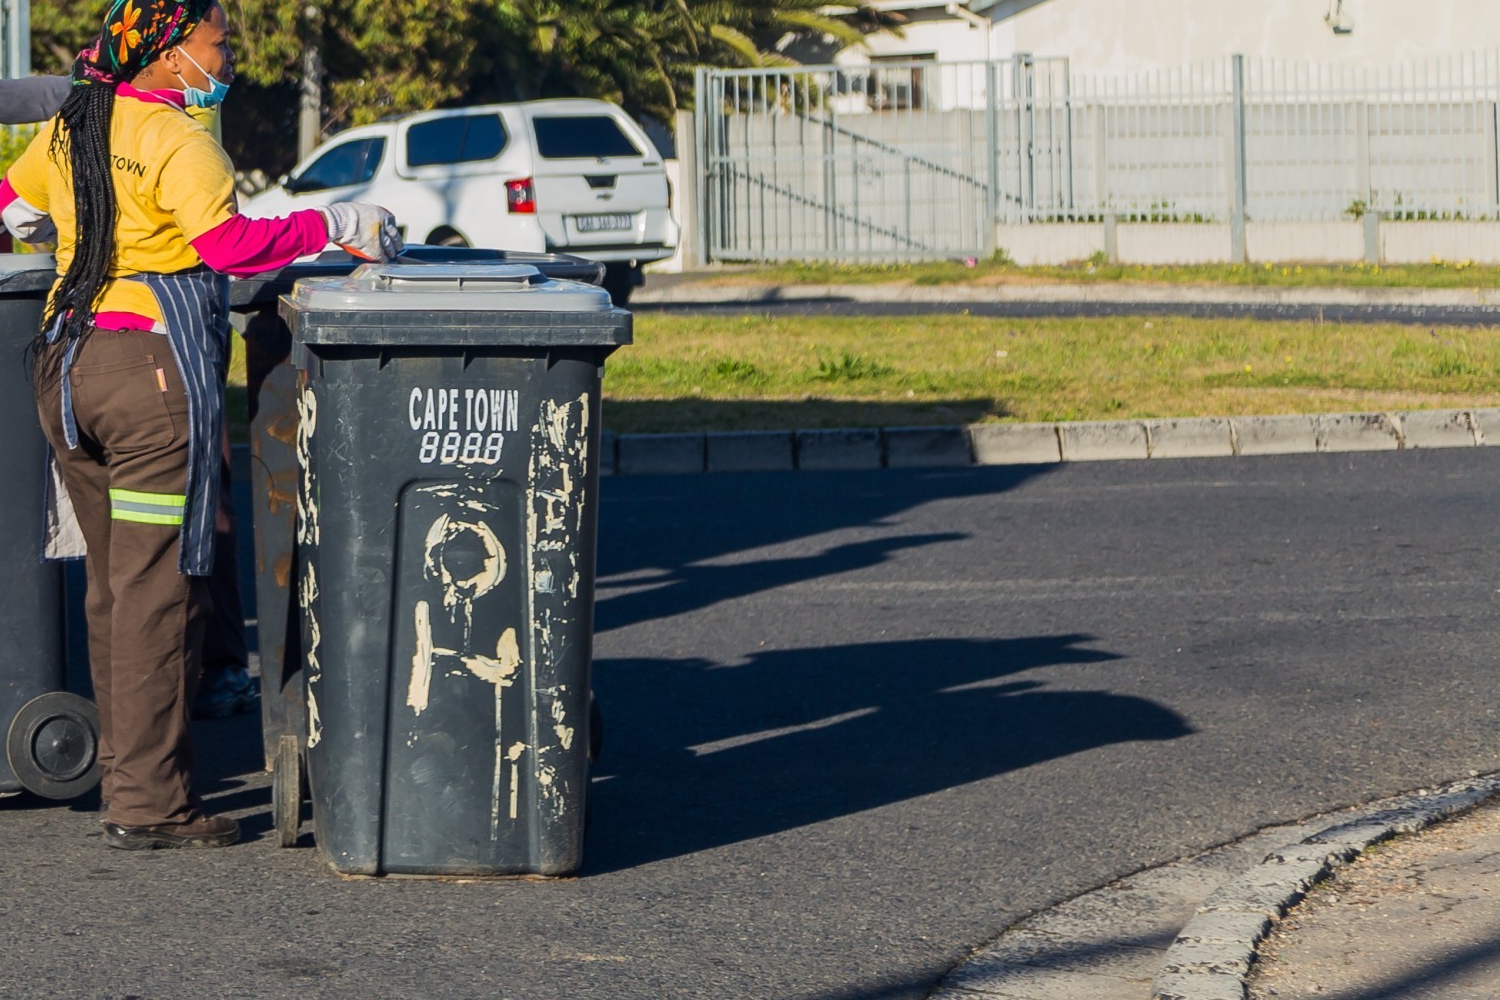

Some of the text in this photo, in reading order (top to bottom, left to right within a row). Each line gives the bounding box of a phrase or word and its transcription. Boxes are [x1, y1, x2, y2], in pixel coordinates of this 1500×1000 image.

[408, 387, 519, 432] CAPE TOWN
[418, 431, 505, 465] 8888
